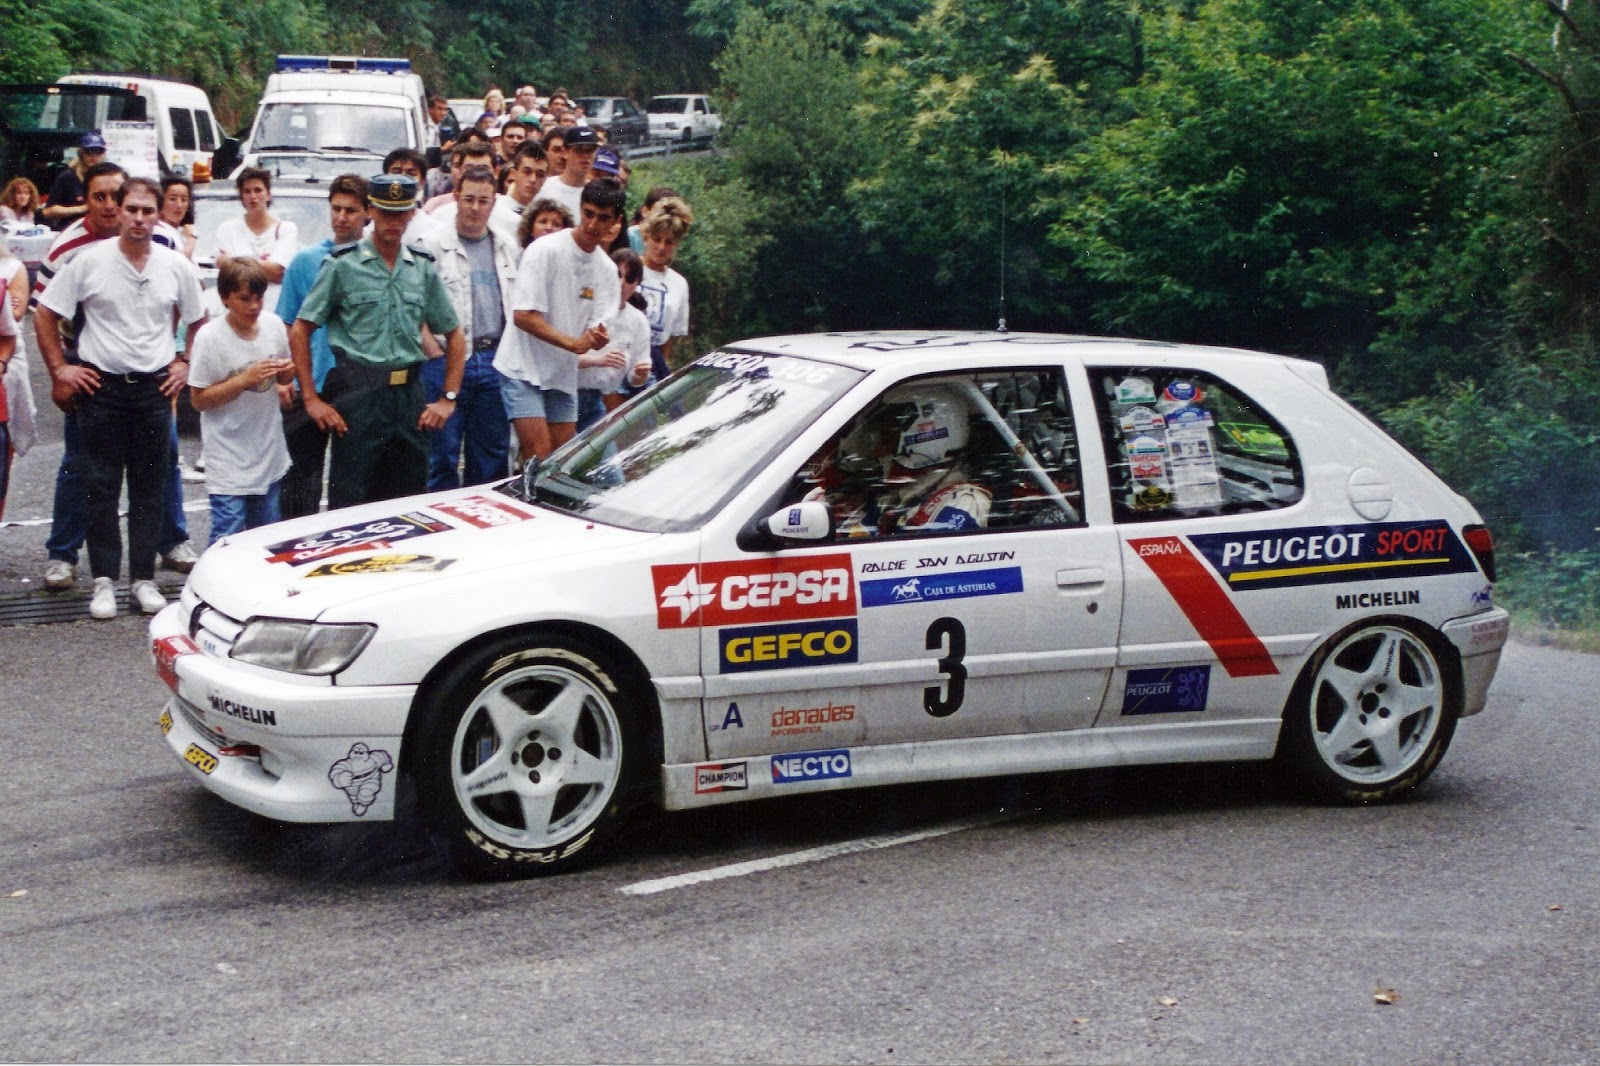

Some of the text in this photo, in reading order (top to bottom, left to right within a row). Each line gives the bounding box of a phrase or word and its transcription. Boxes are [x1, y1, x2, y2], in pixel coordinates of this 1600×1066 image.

[915, 556, 949, 569] SAN
[955, 550, 1016, 565] AGUSTIN
[1139, 540, 1182, 556] ESPAÑA
[1221, 528, 1448, 567] PEUGEOT SPORT
[720, 567, 850, 612] CEPSA
[924, 581, 996, 597] CAJA DE ASTURIAS
[1336, 589, 1420, 610] MICHELIN
[725, 629, 853, 664] GEFCO
[923, 616, 968, 718] 3
[1126, 685, 1172, 697] PEUGEOT
[208, 695, 277, 726] MICHELIN
[721, 702, 744, 730] A
[771, 701, 856, 728] danades
[771, 725, 822, 738] INFORMATICA
[184, 743, 219, 775] GEFCO
[773, 754, 850, 778] NECTO
[699, 771, 744, 785] CHAMPION
